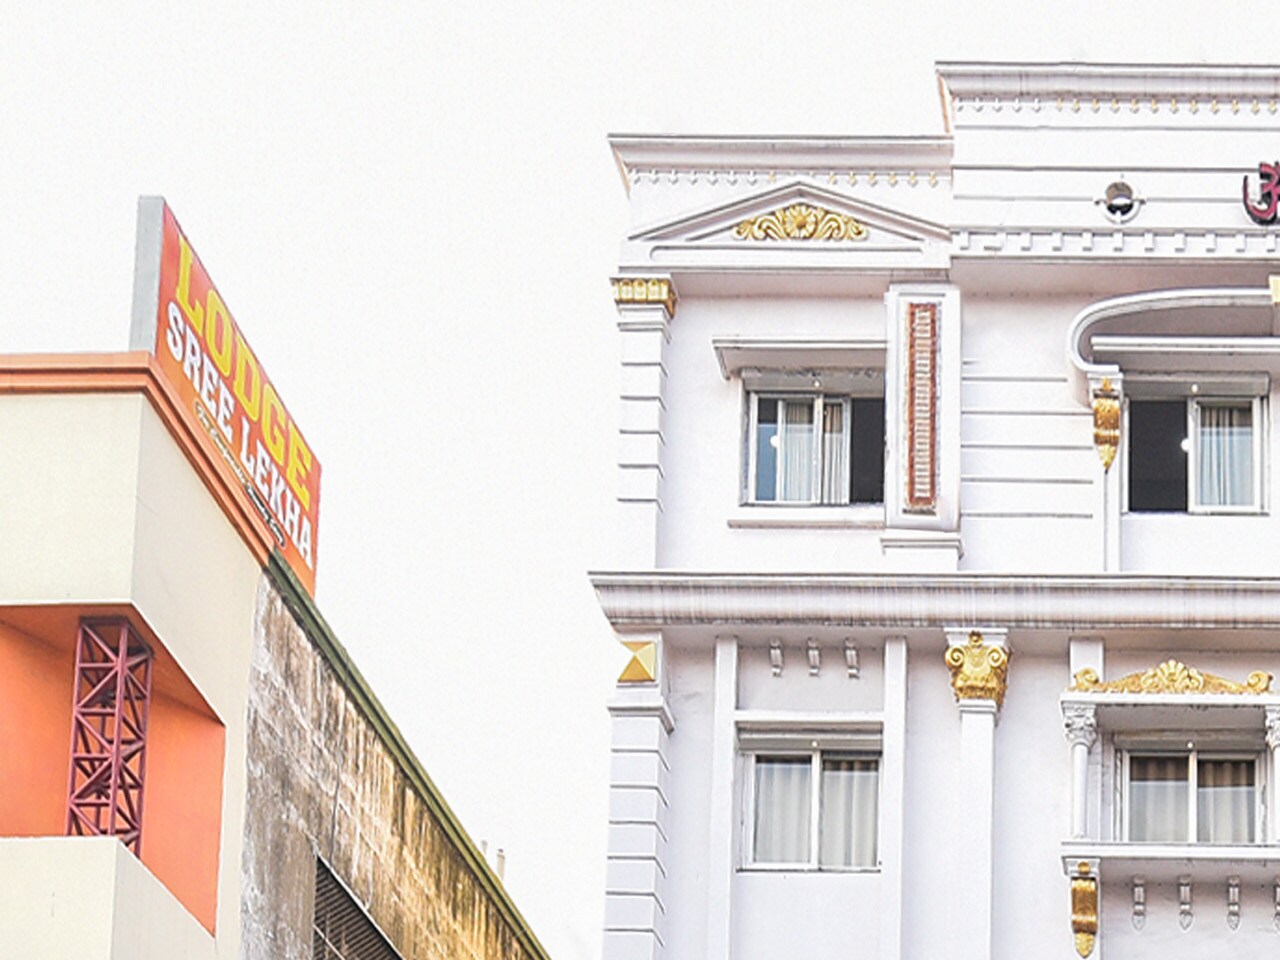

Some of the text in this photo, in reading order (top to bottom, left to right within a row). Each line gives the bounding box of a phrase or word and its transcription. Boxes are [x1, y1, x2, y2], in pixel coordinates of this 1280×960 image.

[166, 300, 235, 440] SREE
[239, 415, 314, 572] LEKHA
[175, 232, 313, 511] LODGE
